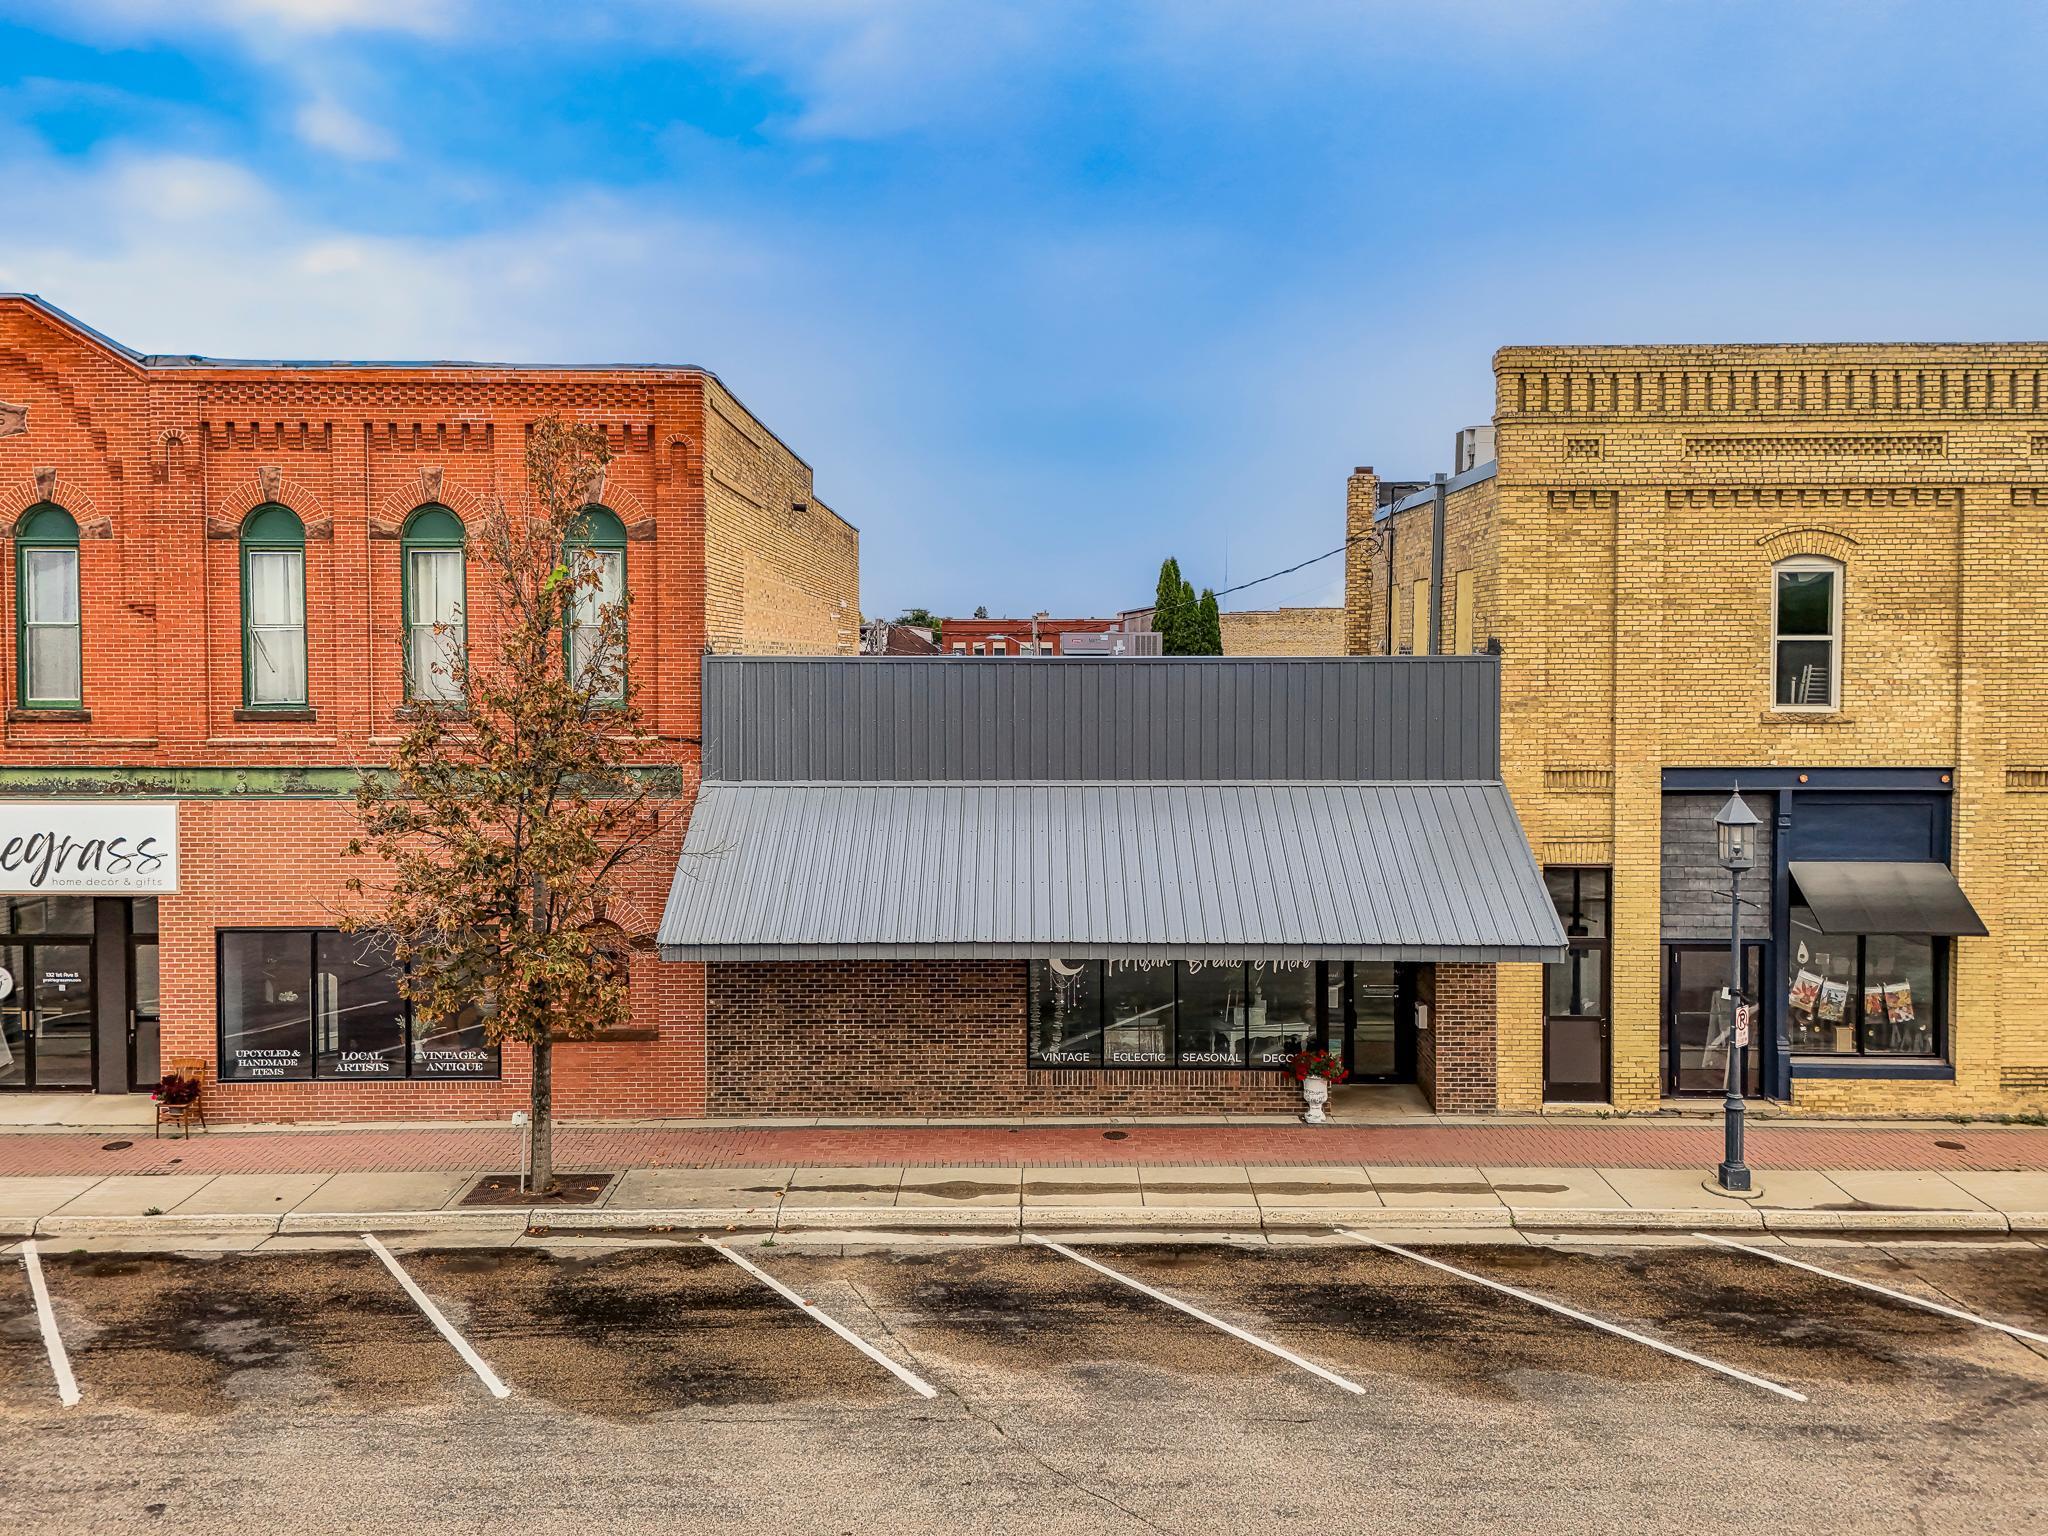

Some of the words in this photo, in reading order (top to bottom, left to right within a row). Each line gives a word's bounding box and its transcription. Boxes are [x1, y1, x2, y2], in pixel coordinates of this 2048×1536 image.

[51, 877, 82, 886] home
[123, 877, 131, 886] &
[135, 876, 164, 889] gifts
[235, 1049, 291, 1058] UPCYCLED
[292, 1049, 301, 1058] &
[341, 1051, 383, 1061] LOCAL
[421, 1051, 477, 1060] VINTAGE
[478, 1051, 488, 1060] &
[1041, 1052, 1090, 1062] VINTAGE
[1113, 1052, 1166, 1062] ECLECTIC
[1182, 1052, 1242, 1063] SEASONAL
[1263, 1053, 1299, 1063] DECO
[238, 1058, 298, 1067] HANDMADE
[335, 1062, 389, 1072] ARTISTS
[426, 1062, 483, 1072] ANTIQUE
[252, 1068, 284, 1076] ITEMS
